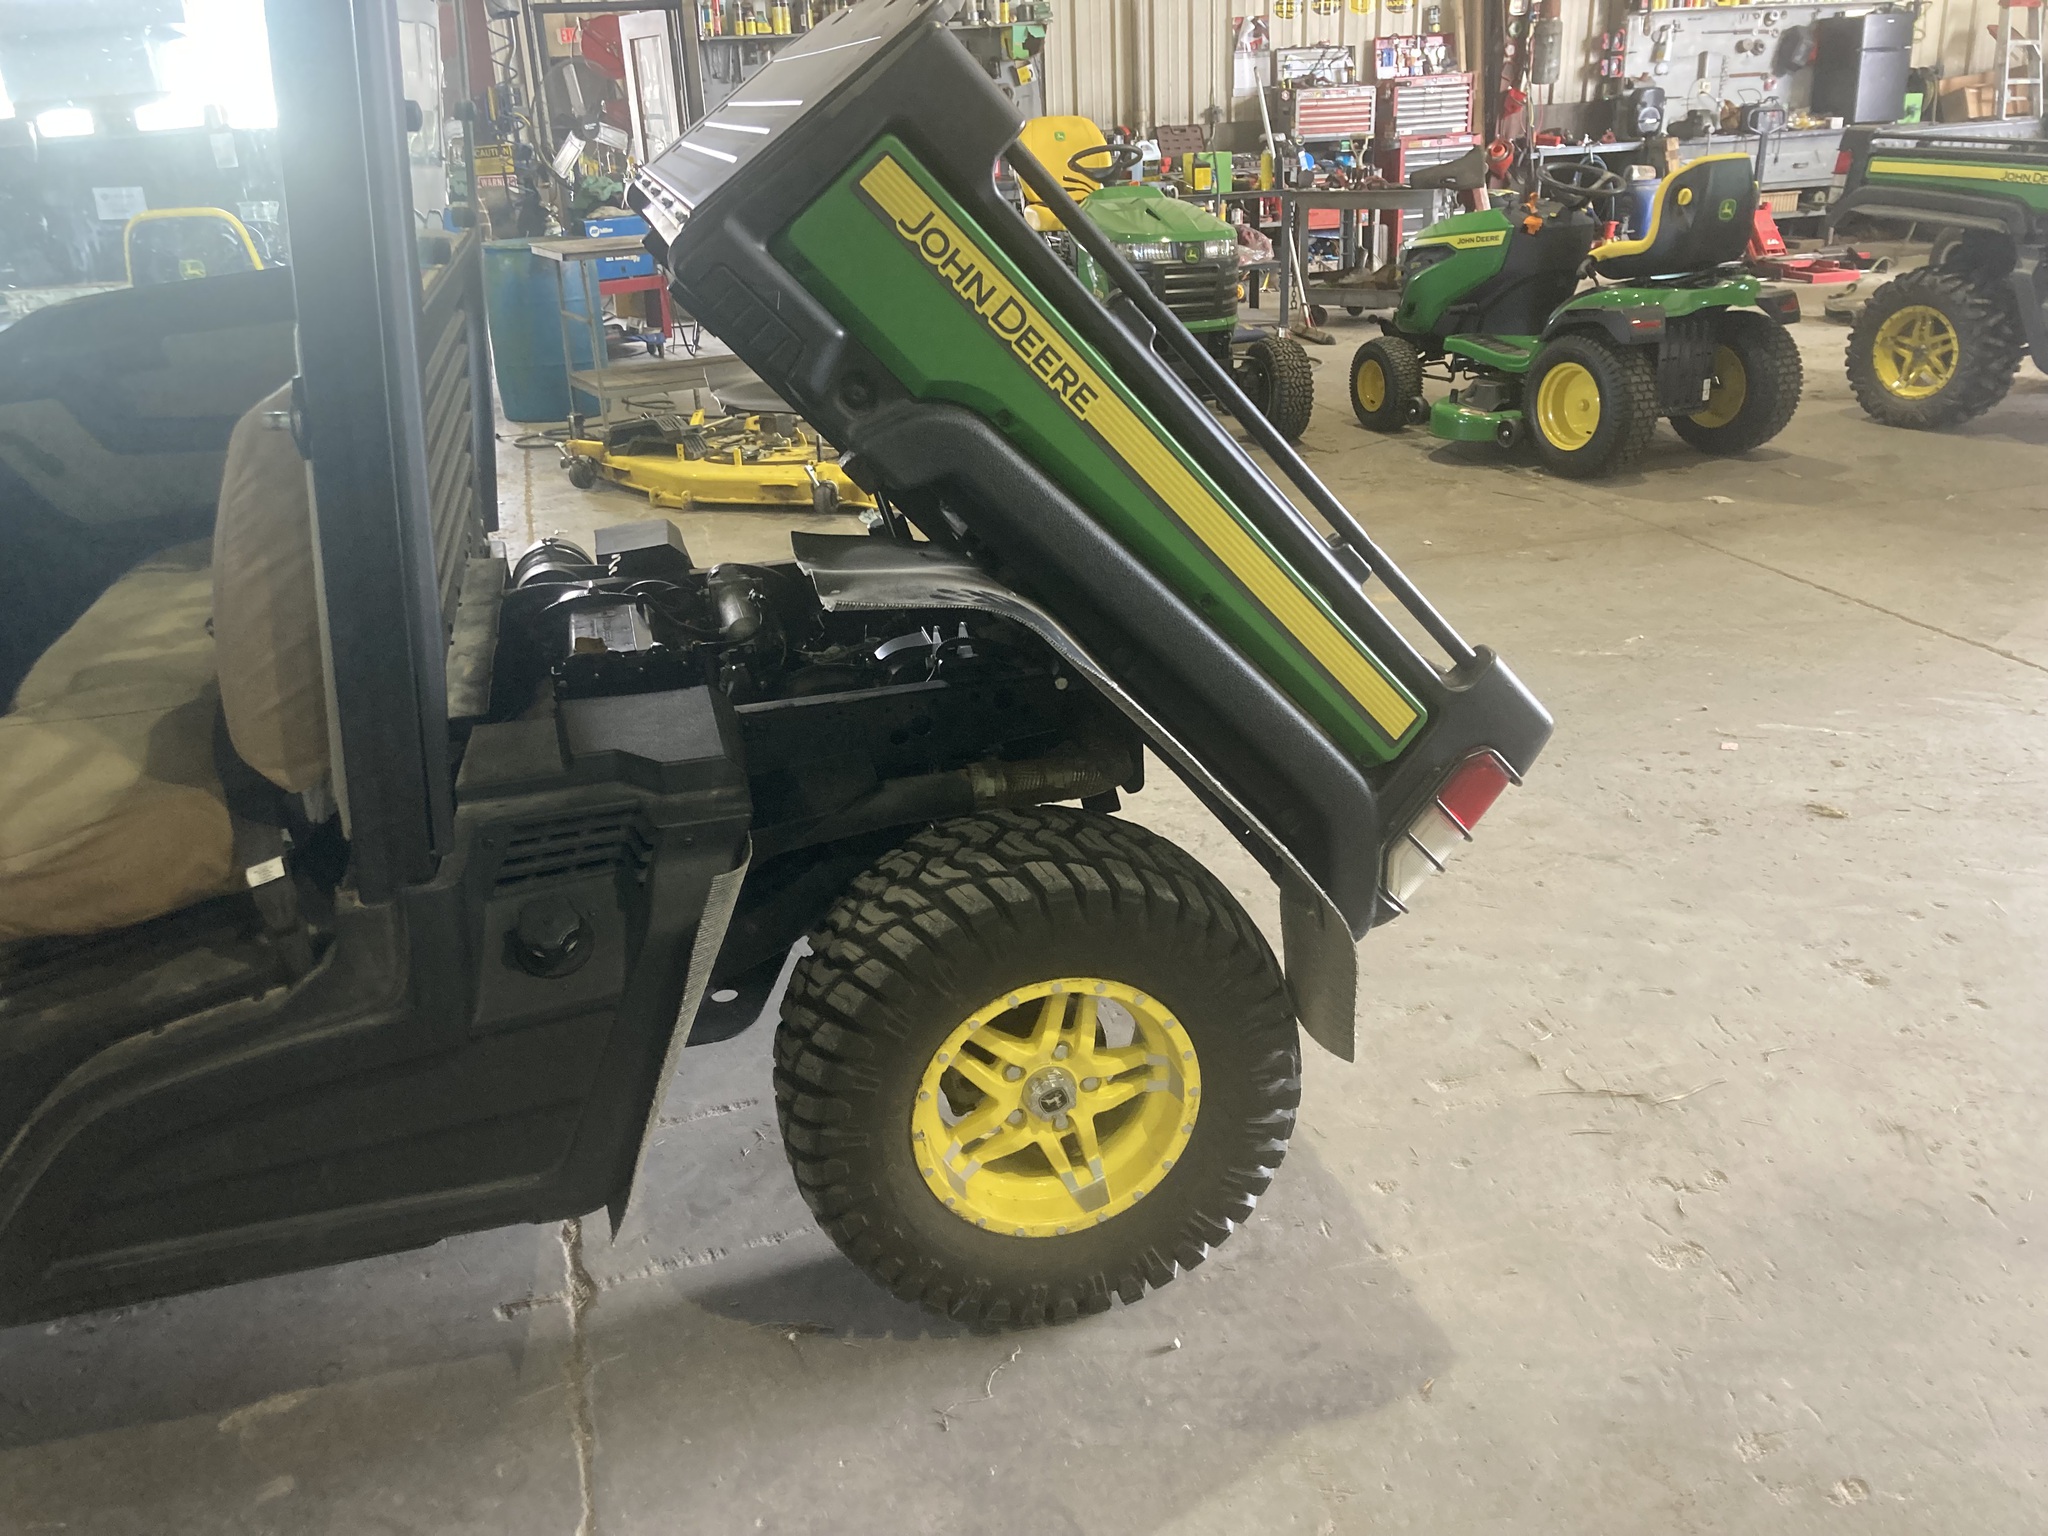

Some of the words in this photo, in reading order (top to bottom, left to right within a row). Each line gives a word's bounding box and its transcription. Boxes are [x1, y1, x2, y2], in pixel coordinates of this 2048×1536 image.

[475, 147, 510, 158] CAUTIN
[2000, 170, 2031, 181] JOHN
[1457, 237, 1475, 245] JOHN
[898, 211, 997, 308] JOHN
[991, 295, 1099, 415] DEERE
